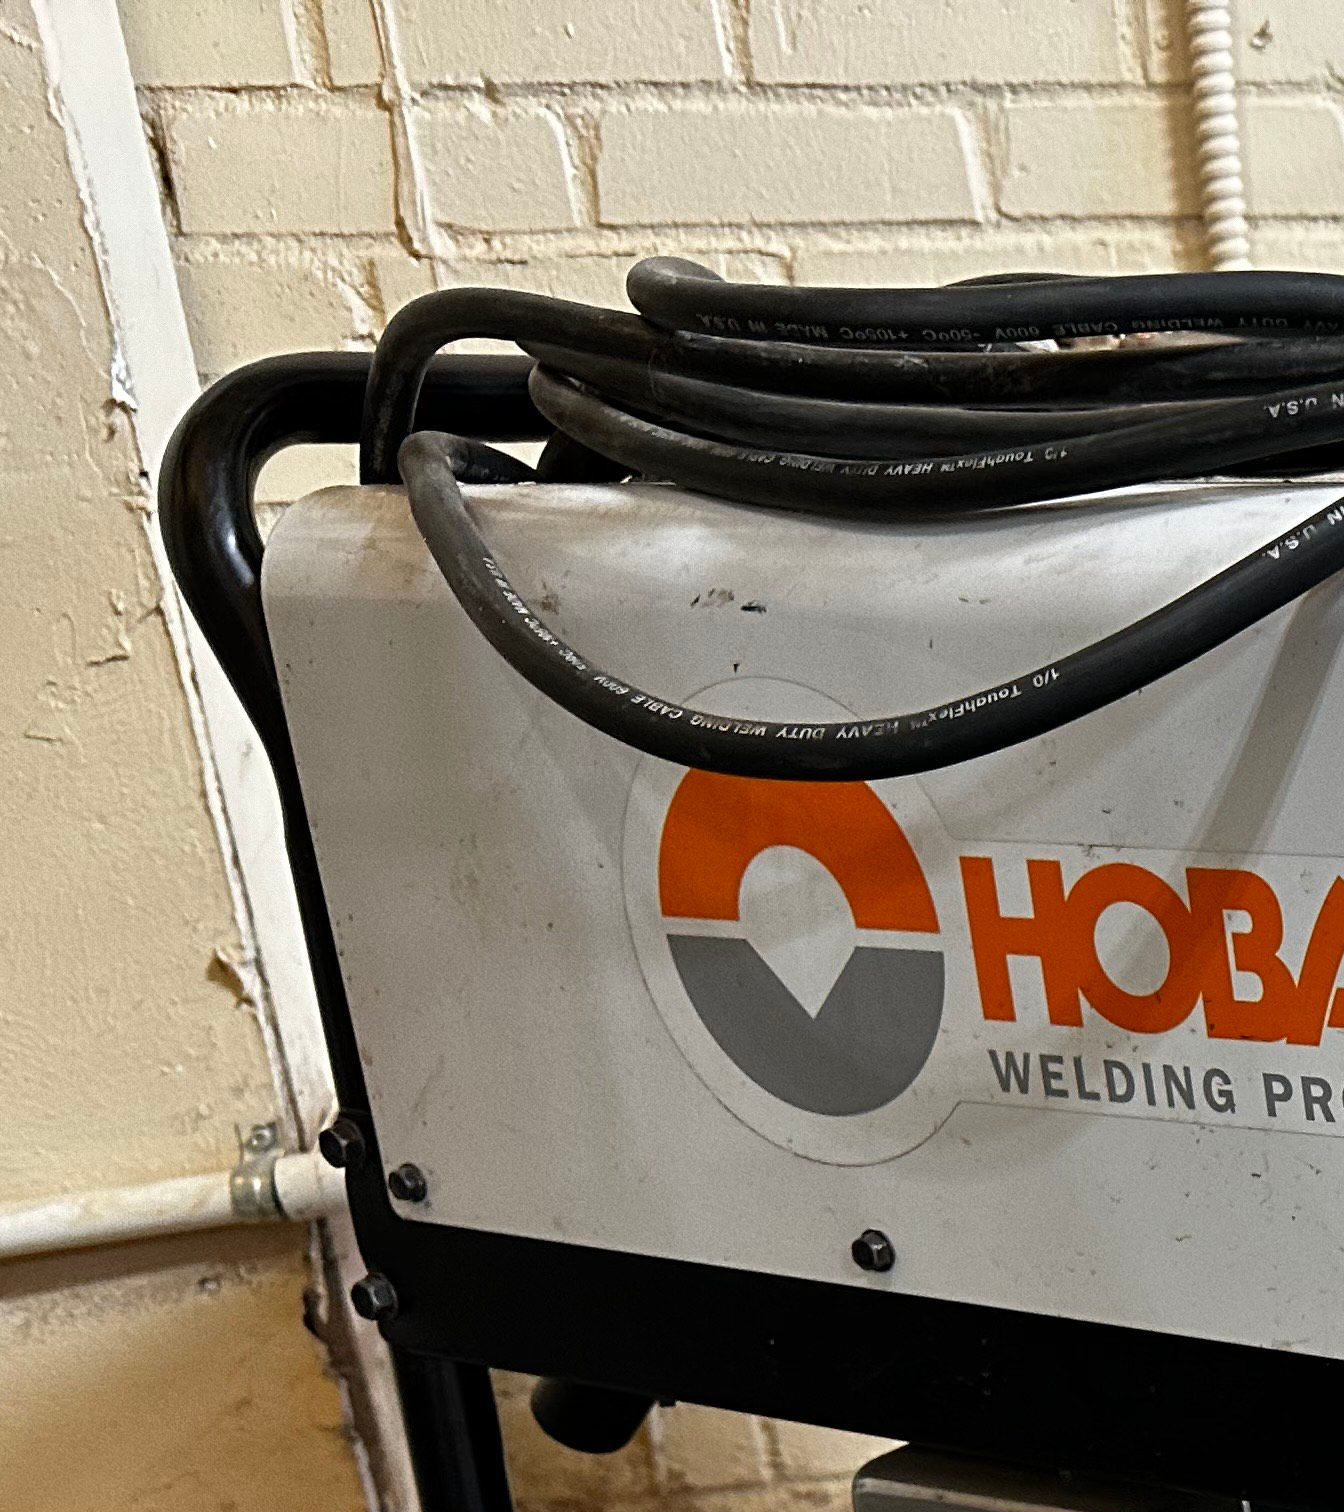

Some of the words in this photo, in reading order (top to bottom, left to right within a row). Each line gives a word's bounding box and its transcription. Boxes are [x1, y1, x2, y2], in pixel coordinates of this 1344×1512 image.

[995, 325, 1040, 339] 600V
[1052, 320, 1118, 337] CABLE
[1131, 317, 1224, 331] WELDING
[884, 461, 933, 476] HEAVY
[1261, 525, 1318, 560] U.S.A.
[1033, 667, 1060, 688] 1/0
[630, 694, 684, 720] CABLE
[689, 714, 767, 737] WELDING
[775, 725, 825, 741] DUTY
[835, 720, 900, 740] HEAVY
[987, 1048, 1236, 1115] WELDING
